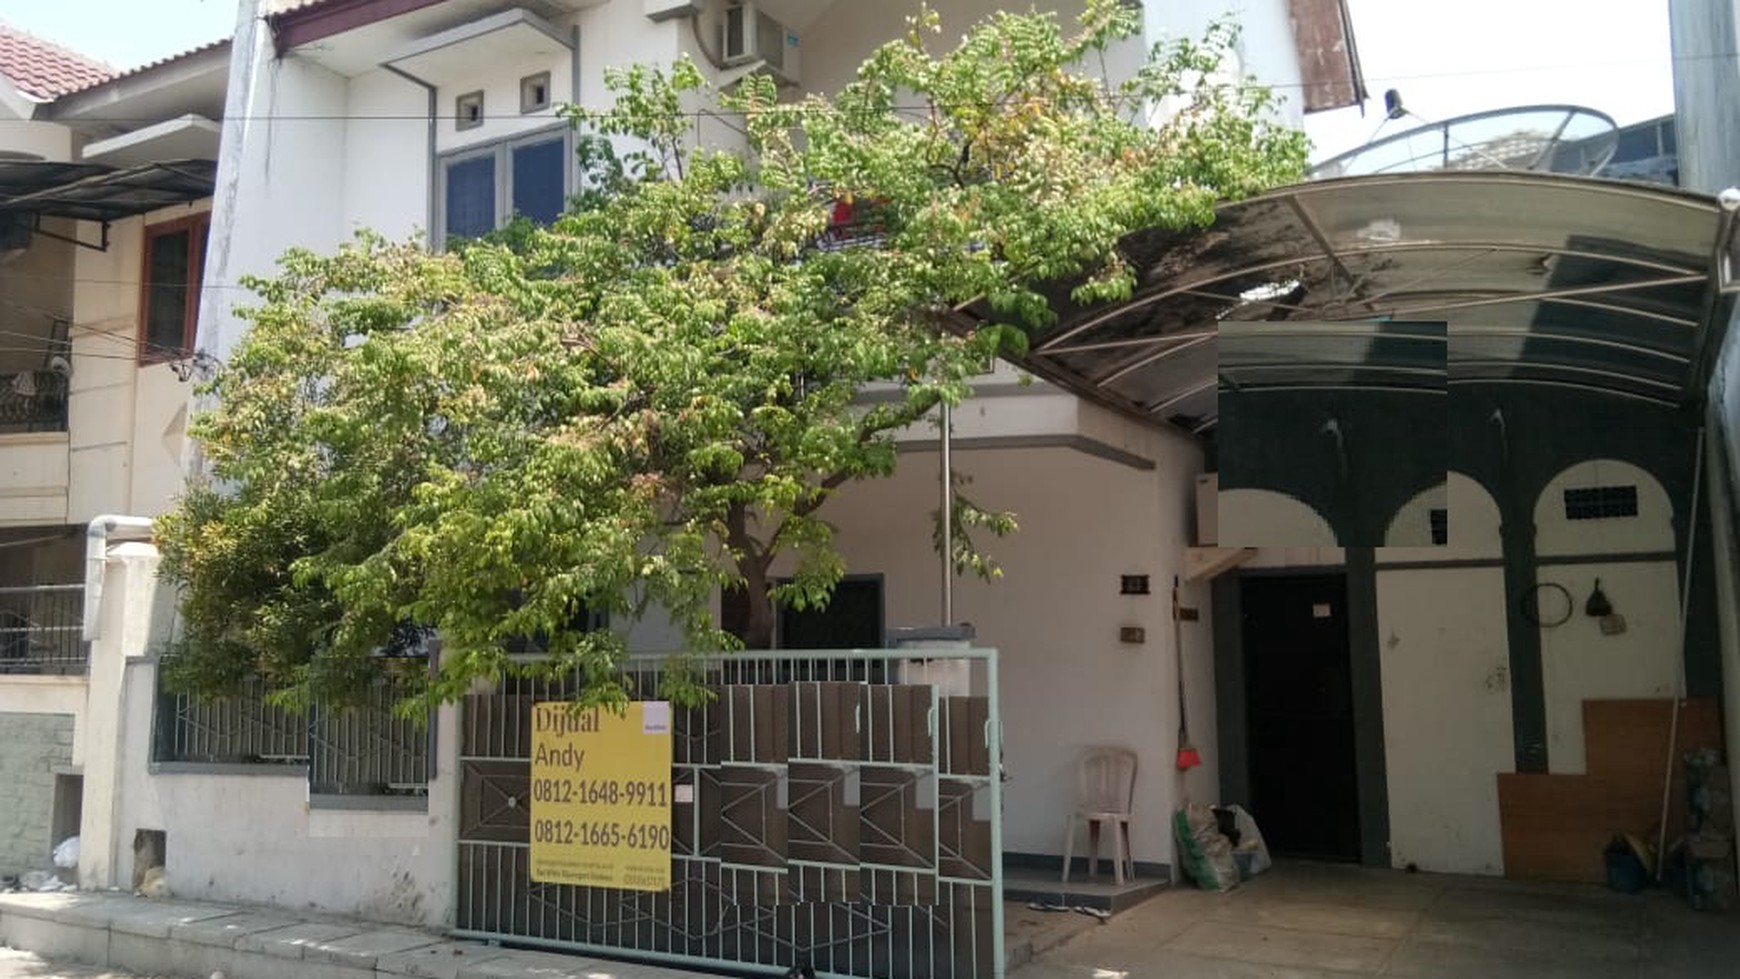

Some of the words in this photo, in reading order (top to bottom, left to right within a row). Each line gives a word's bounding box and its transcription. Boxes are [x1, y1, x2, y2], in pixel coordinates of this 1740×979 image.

[535, 743, 584, 772] Andy
[534, 778, 667, 807] 0812-1648-9911
[535, 819, 669, 850] 0812-1665-6190
